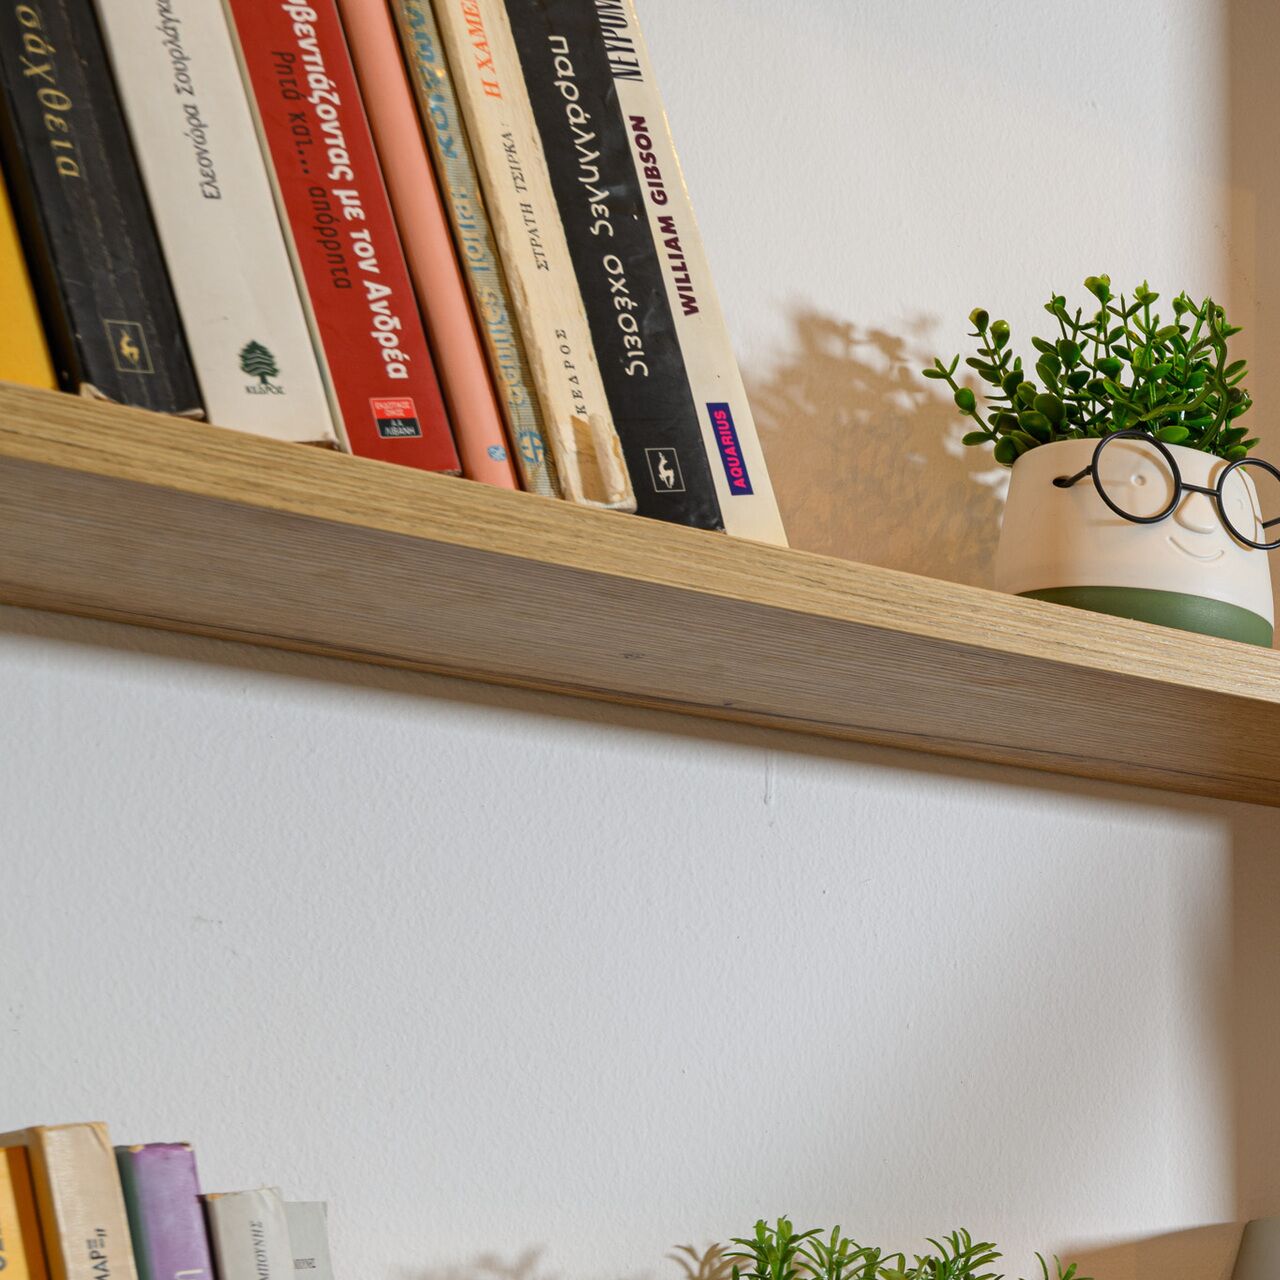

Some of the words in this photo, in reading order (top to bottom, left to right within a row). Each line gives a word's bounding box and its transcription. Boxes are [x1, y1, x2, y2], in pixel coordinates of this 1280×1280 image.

[15, 4, 80, 178] σάχθεια
[482, 81, 502, 100] Η
[180, 104, 222, 200] Ελεονώρα
[272, 51, 301, 101] Ρητά
[309, 186, 352, 290] απόρρητα
[629, 115, 668, 206] GIBSON
[332, 188, 365, 222] με
[520, 203, 550, 271] ΣΤΡΑΤΗ
[548, 35, 614, 237] παράλληλες
[603, 254, 649, 377] σχέσεις
[351, 229, 381, 274] τον
[657, 215, 701, 318] WILLIAM
[363, 280, 411, 380] Ανδρέα
[556, 329, 588, 416] ΚΕΔΡΟΣ
[713, 409, 747, 489] AQUARIUS
